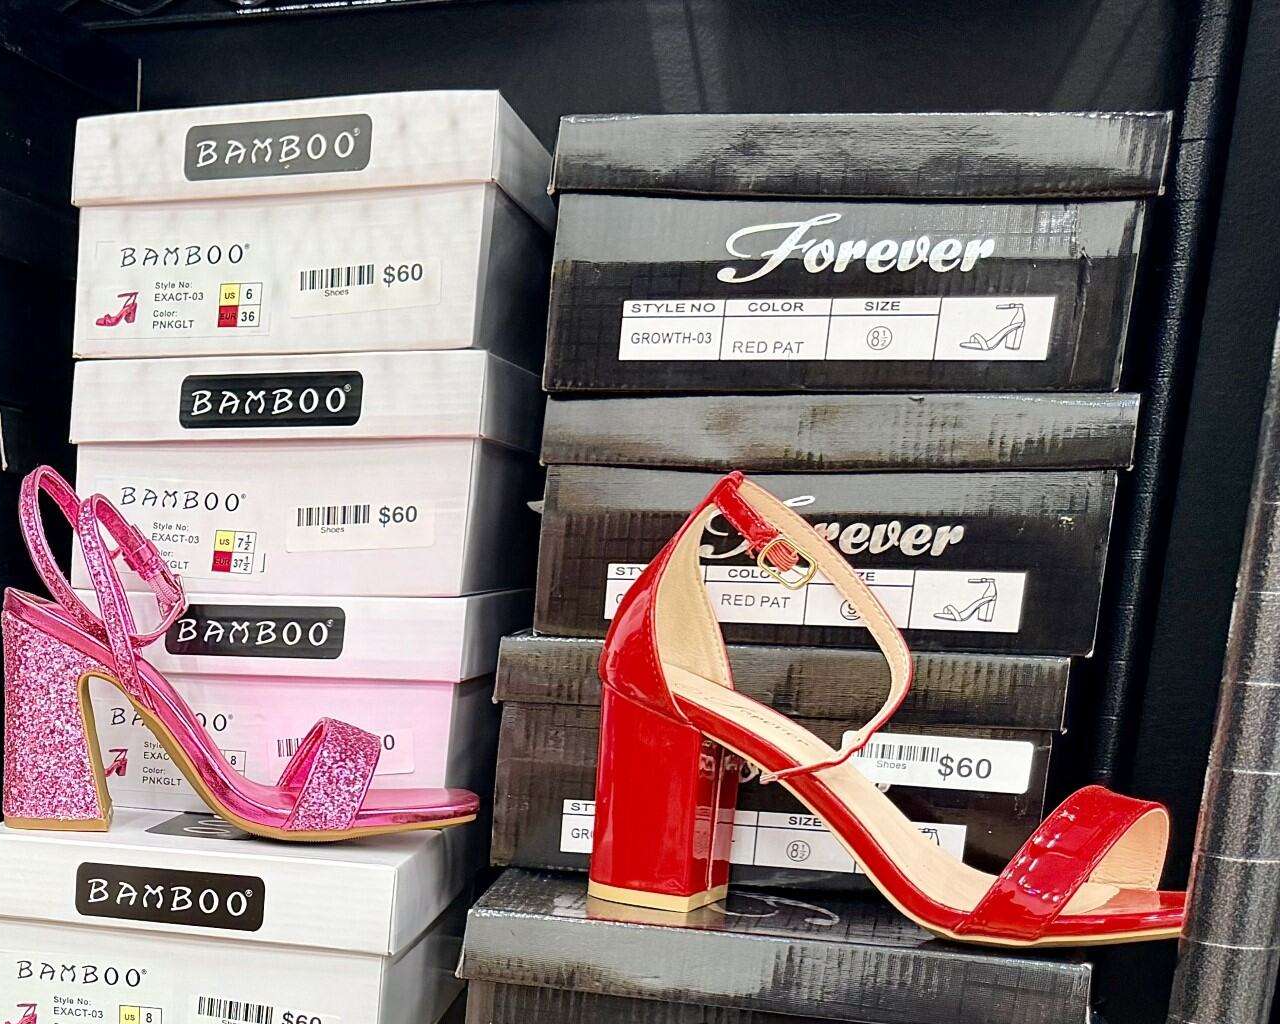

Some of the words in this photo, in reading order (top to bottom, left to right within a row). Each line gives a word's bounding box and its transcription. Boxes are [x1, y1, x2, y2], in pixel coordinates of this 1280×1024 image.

[717, 213, 995, 284] Forever
[383, 263, 423, 288] $60
[154, 292, 204, 302] EXACT-03
[246, 288, 252, 299] 6
[325, 288, 348, 297] Shoes
[631, 303, 685, 313] STYLE
[690, 302, 715, 313] NO
[748, 302, 804, 312] COLOR
[864, 301, 900, 311] SIZE
[153, 310, 178, 318] Color:
[241, 311, 255, 322] 36
[152, 319, 194, 330] PNKGLT
[631, 332, 712, 345] GROWTH-03
[732, 341, 768, 354] RED
[772, 342, 804, 354] PAT
[379, 506, 418, 526] $60
[152, 533, 199, 544] EXACT-03
[721, 594, 754, 609] RED
[759, 595, 791, 609] PAT
[877, 759, 907, 771] Shoes
[937, 755, 992, 780] $60
[142, 776, 182, 786] PNKGLT
[788, 815, 822, 827] SIZE
[53, 1007, 103, 1019] EXACT-03
[146, 1012, 152, 1023] 8
